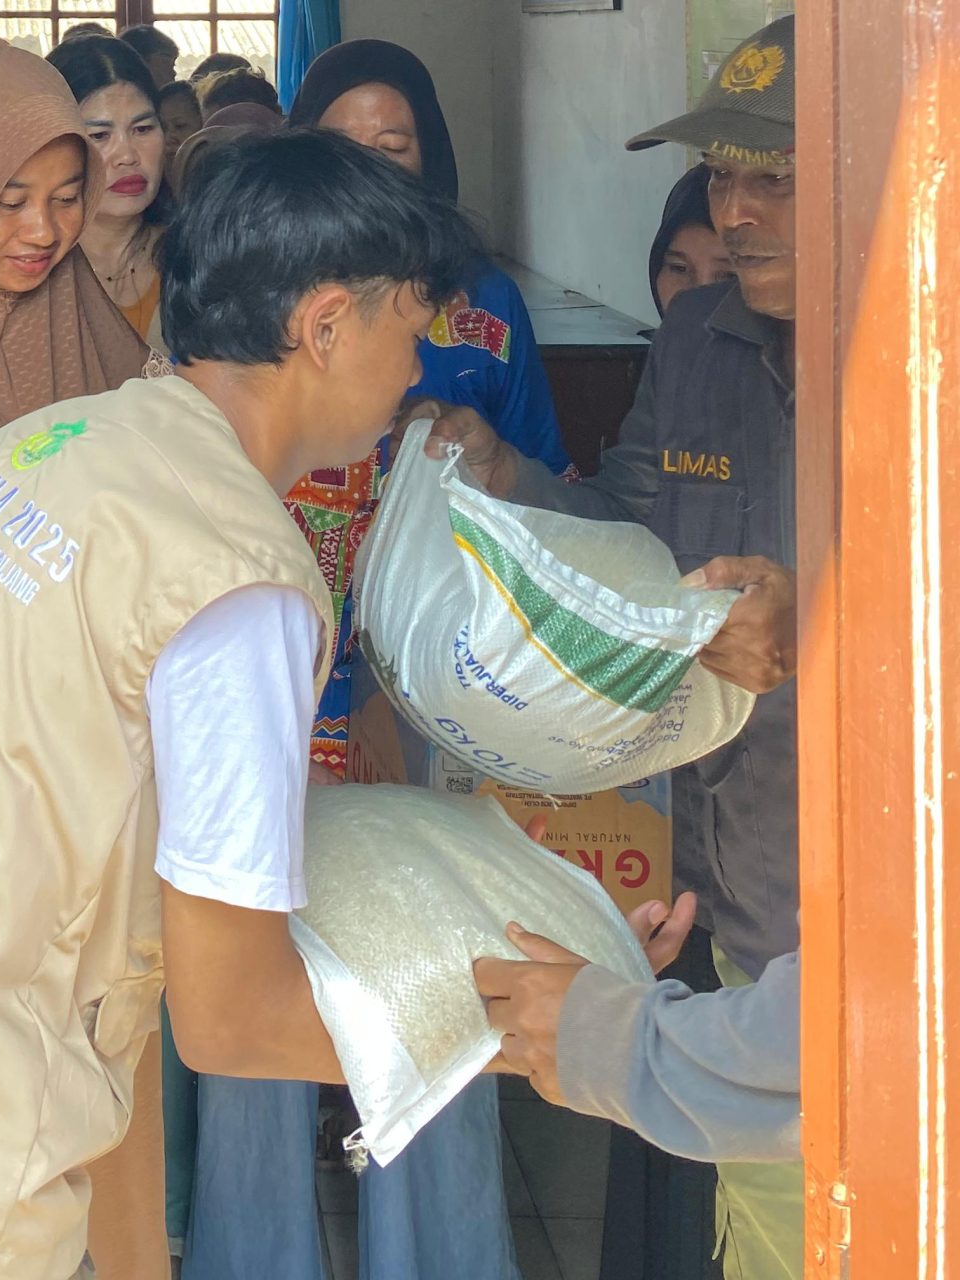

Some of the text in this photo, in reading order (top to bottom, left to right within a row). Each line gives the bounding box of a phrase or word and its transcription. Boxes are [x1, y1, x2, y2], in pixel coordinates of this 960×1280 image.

[662, 449, 732, 481] LIMAS
[0, 500, 81, 583] 2025
[541, 832, 631, 843] NATURAL MIN
